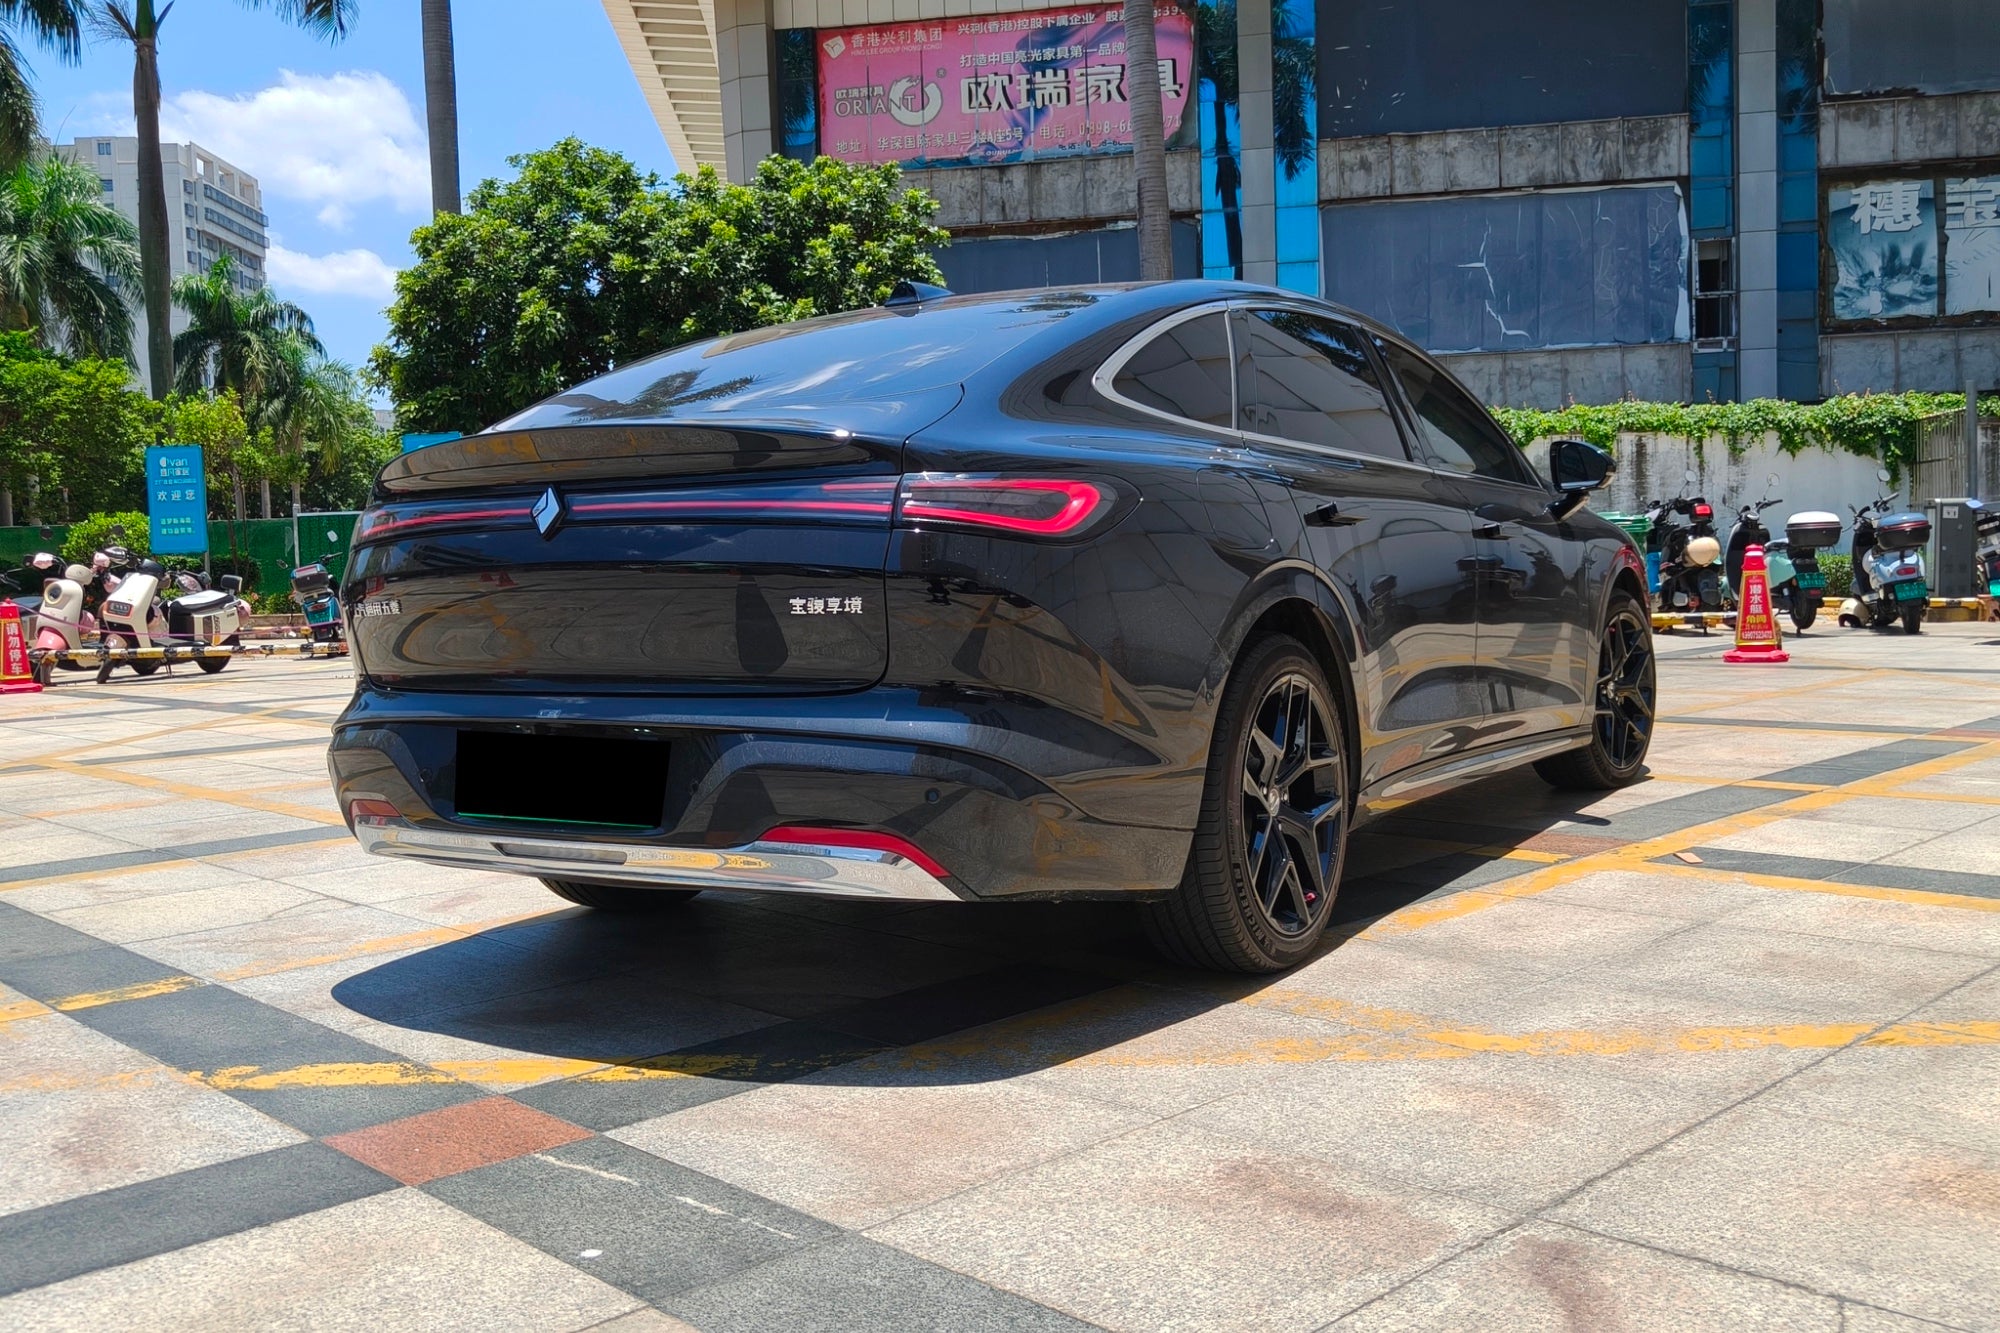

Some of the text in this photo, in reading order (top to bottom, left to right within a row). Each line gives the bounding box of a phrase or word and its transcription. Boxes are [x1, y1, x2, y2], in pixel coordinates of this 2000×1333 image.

[850, 27, 943, 49] 香港兴利集团
[789, 596, 863, 615] 宝骏享境
[6, 622, 24, 675] 请勿停车
